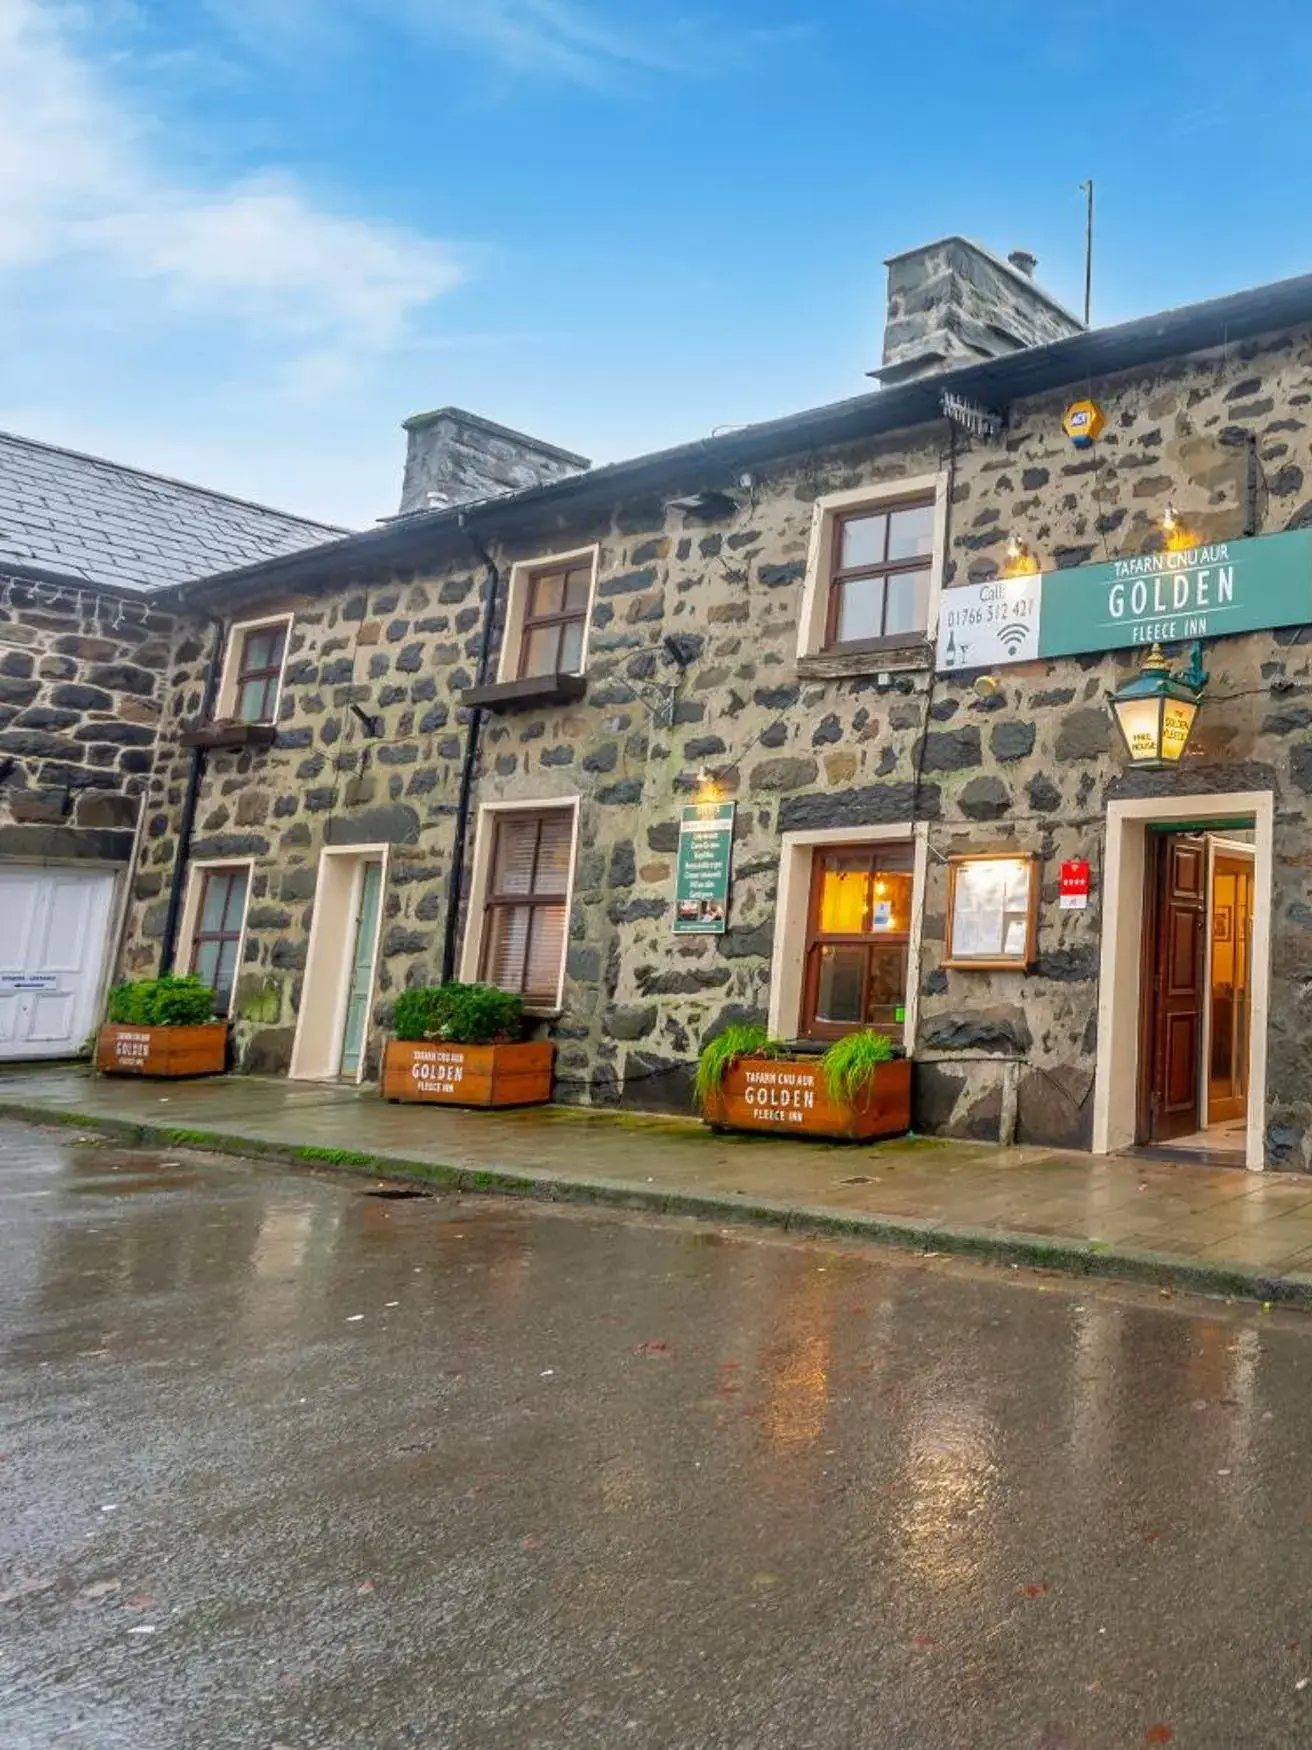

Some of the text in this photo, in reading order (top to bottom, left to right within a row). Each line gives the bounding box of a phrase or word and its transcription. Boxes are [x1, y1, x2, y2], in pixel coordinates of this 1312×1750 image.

[1114, 544, 1229, 578] TAFARN CNU AUR
[1108, 565, 1234, 618] GOLDEN
[947, 607, 983, 628] 01766
[986, 602, 1009, 622] 512
[1132, 617, 1208, 644] FLEECE INN
[411, 1063, 464, 1082] GOLDEN
[745, 1071, 815, 1087] TAFARN CNU AUR
[744, 1086, 814, 1109] GOLDEN
[753, 1108, 804, 1123] FLEECE INN
